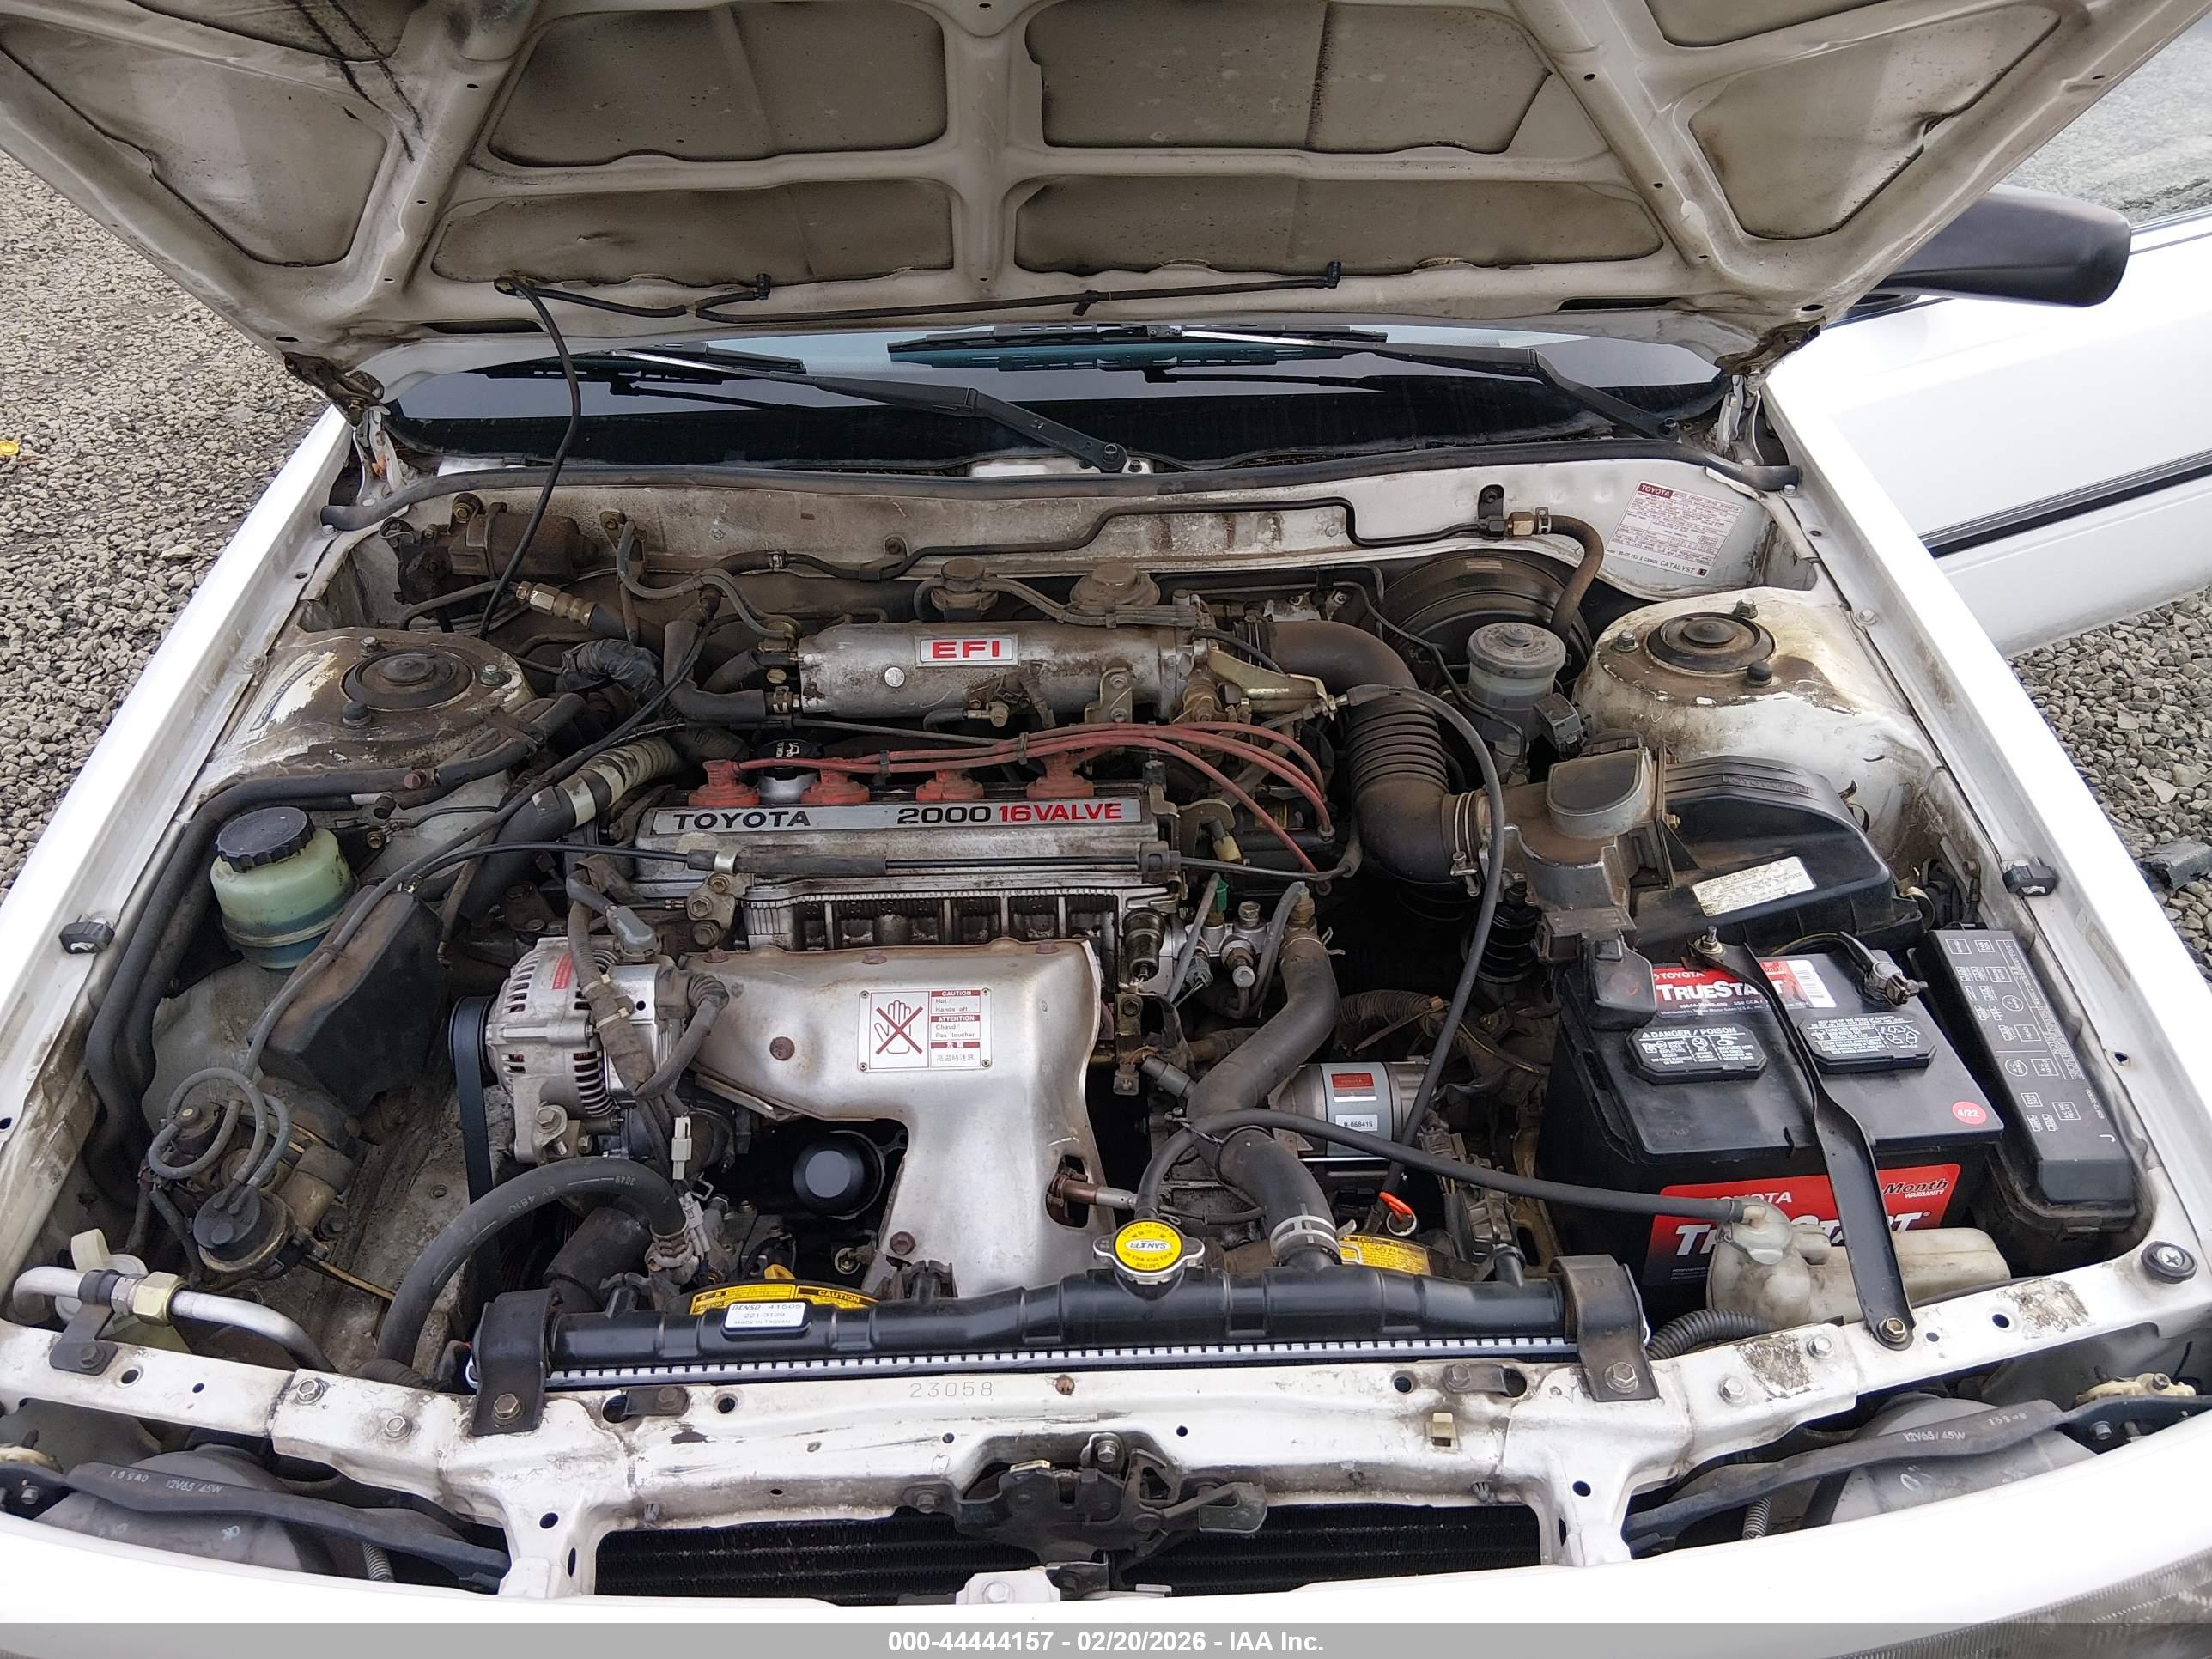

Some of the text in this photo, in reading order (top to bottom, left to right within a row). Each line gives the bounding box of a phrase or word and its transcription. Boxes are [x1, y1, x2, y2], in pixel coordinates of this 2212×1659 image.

[1640, 484, 1670, 498] TOYOTA
[1660, 559, 1696, 574] CATALYST
[932, 641, 1000, 659] EFI
[673, 811, 811, 830] TOYOTA
[897, 806, 992, 824] 2000
[1650, 1030, 1691, 1038] DANGER
[1957, 1108, 1980, 1118] 4/22
[1884, 1178, 1948, 1194] Month
[1904, 1189, 1944, 1199] WARRANTY
[818, 1290, 860, 1303] CAUTION
[909, 1381, 993, 1398] 23058
